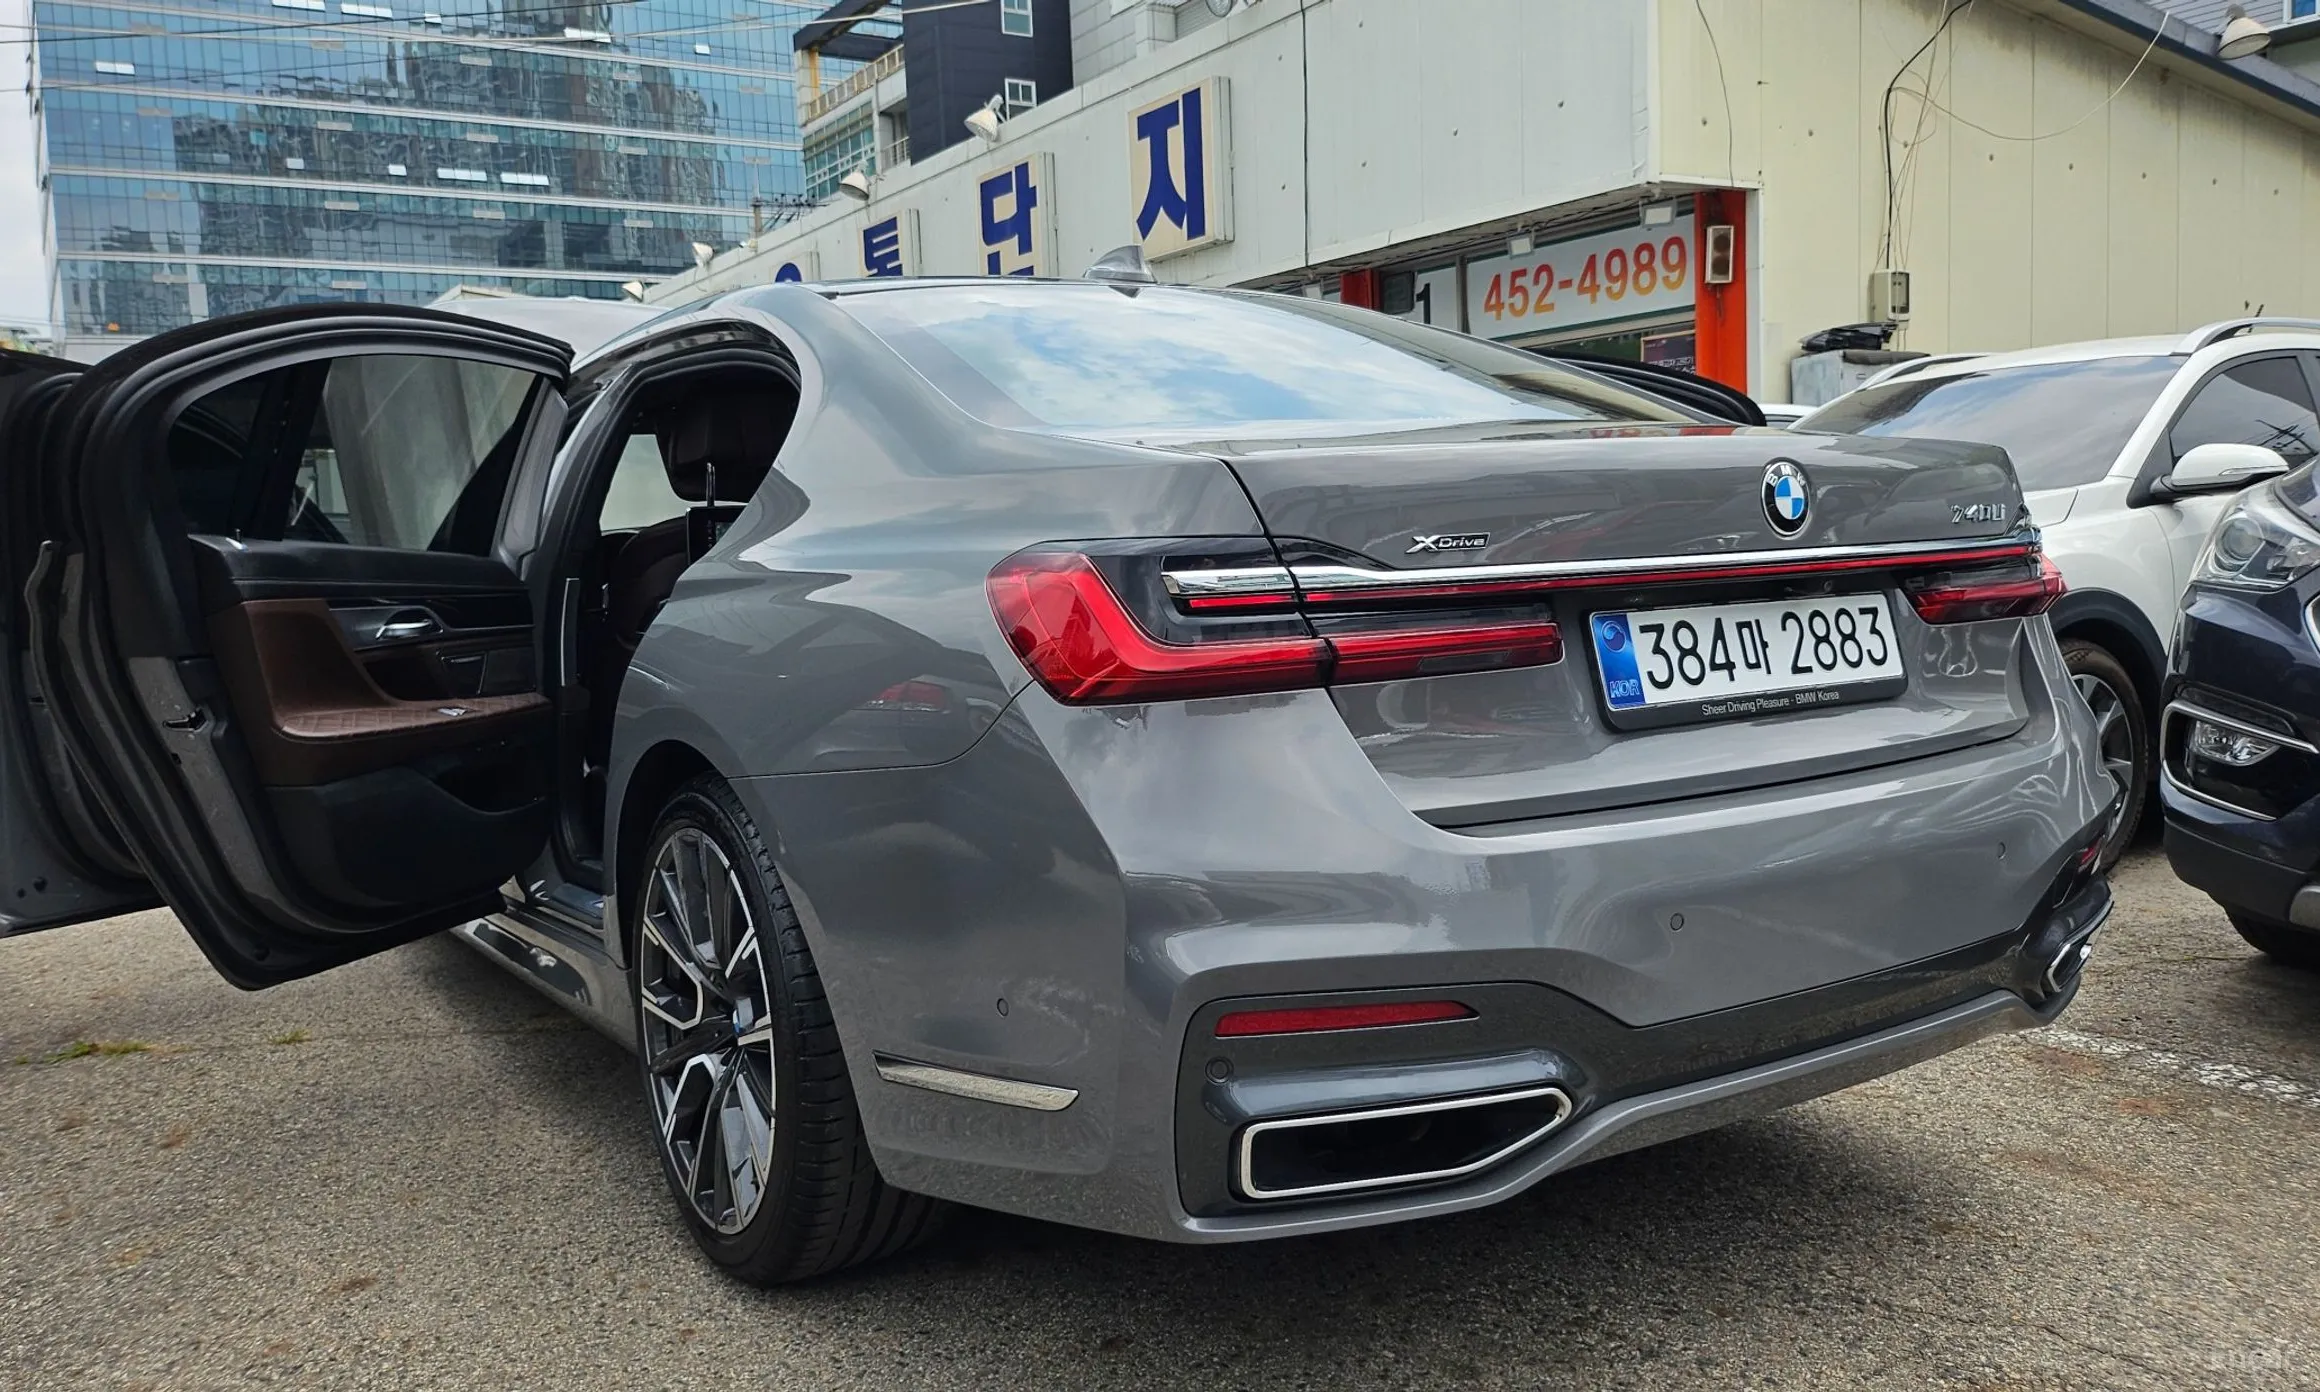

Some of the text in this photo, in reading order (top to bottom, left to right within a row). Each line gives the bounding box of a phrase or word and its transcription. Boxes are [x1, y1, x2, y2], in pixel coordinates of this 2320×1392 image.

[1483, 235, 1687, 321] 452-4989
[1766, 464, 1806, 488] BMW
[1639, 606, 1889, 690] 384마 2883
[1609, 678, 1640, 699] KOR
[1701, 703, 1727, 716] Sheer
[1727, 700, 1756, 713] Driving
[1756, 696, 1790, 710] Pleasure
[1794, 691, 1817, 704] BMW
[1817, 690, 1840, 701] Korea
